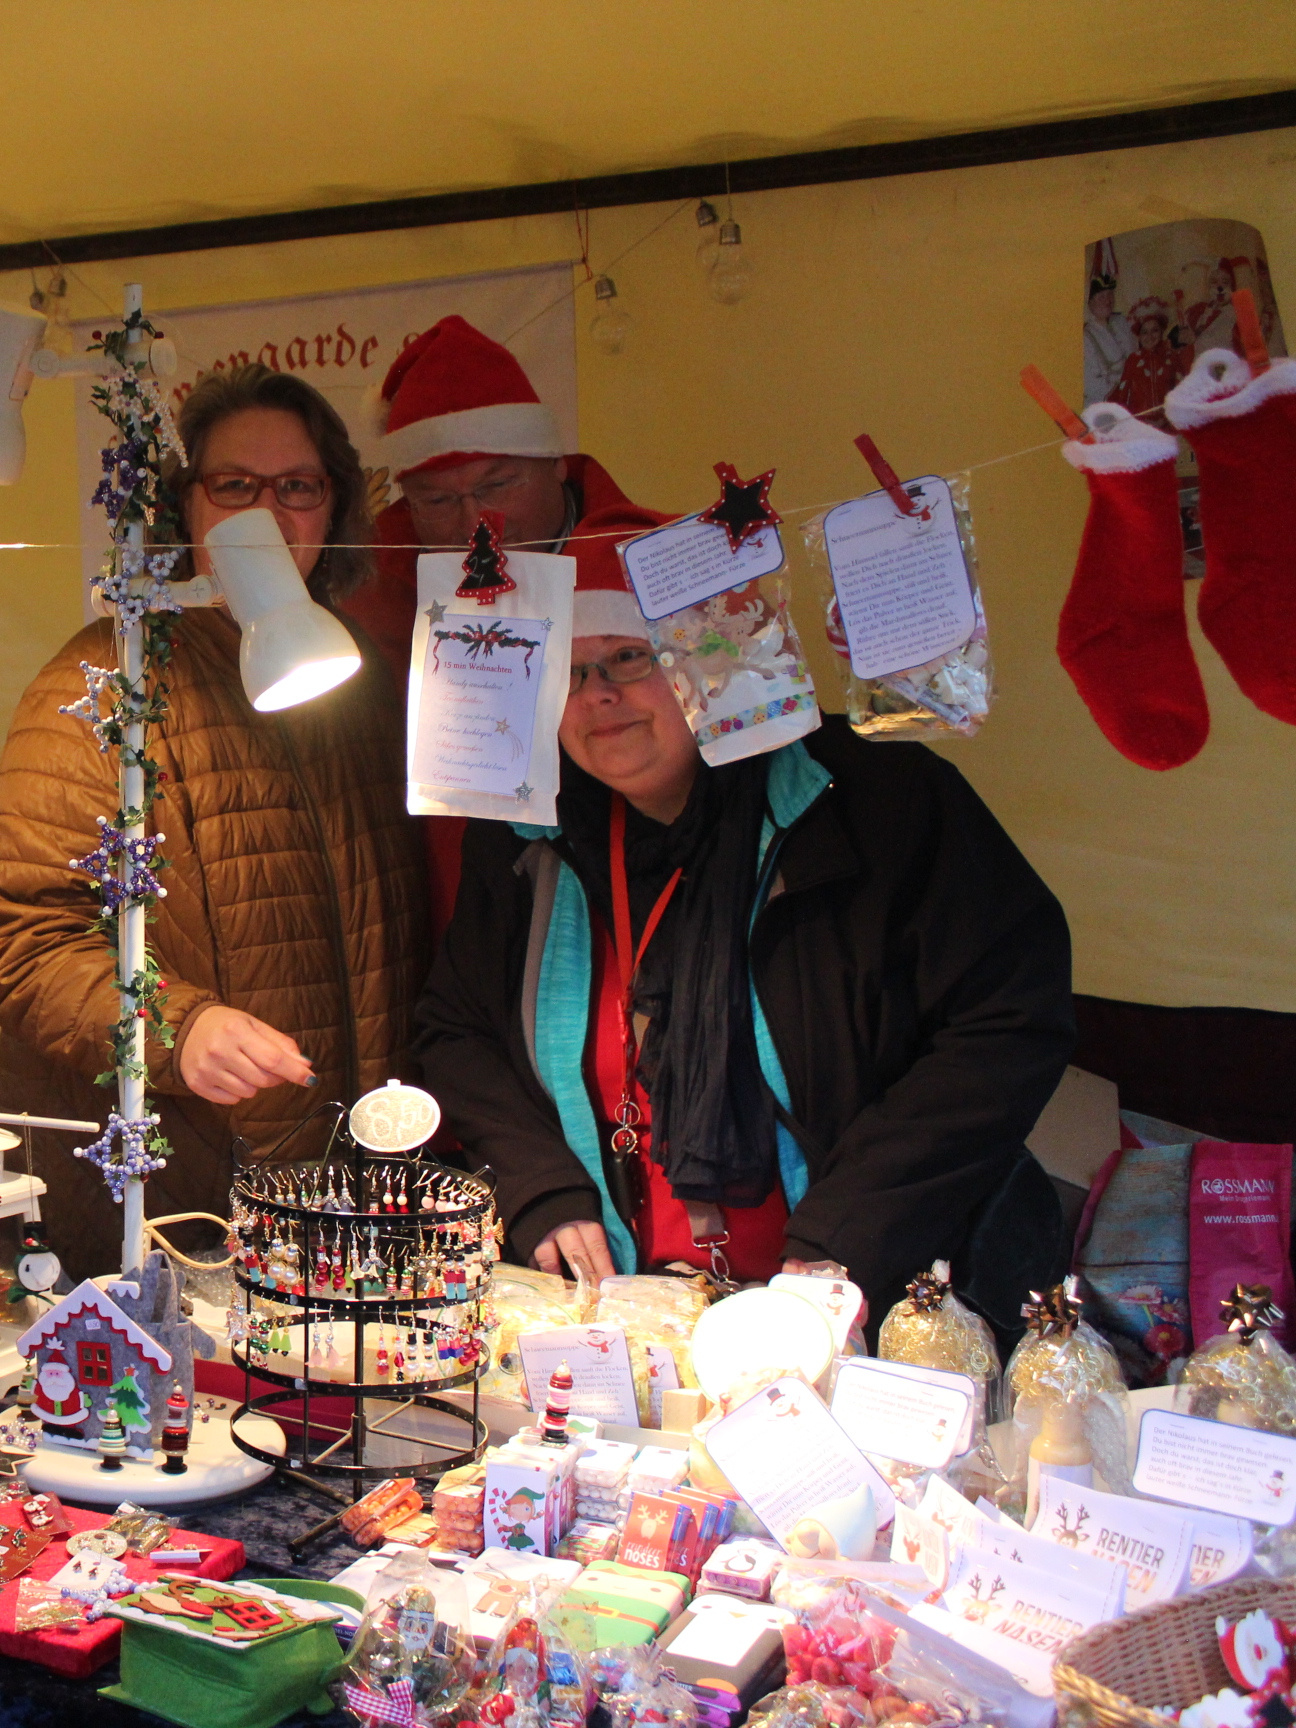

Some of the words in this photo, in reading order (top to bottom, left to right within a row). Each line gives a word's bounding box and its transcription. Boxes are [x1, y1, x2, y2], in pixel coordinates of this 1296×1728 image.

[468, 662, 513, 674] Weihnachten
[1096, 1527, 1165, 1569] RENTIER
[993, 1618, 1068, 1655] NASEN
[1010, 1599, 1083, 1637] RENTIER
